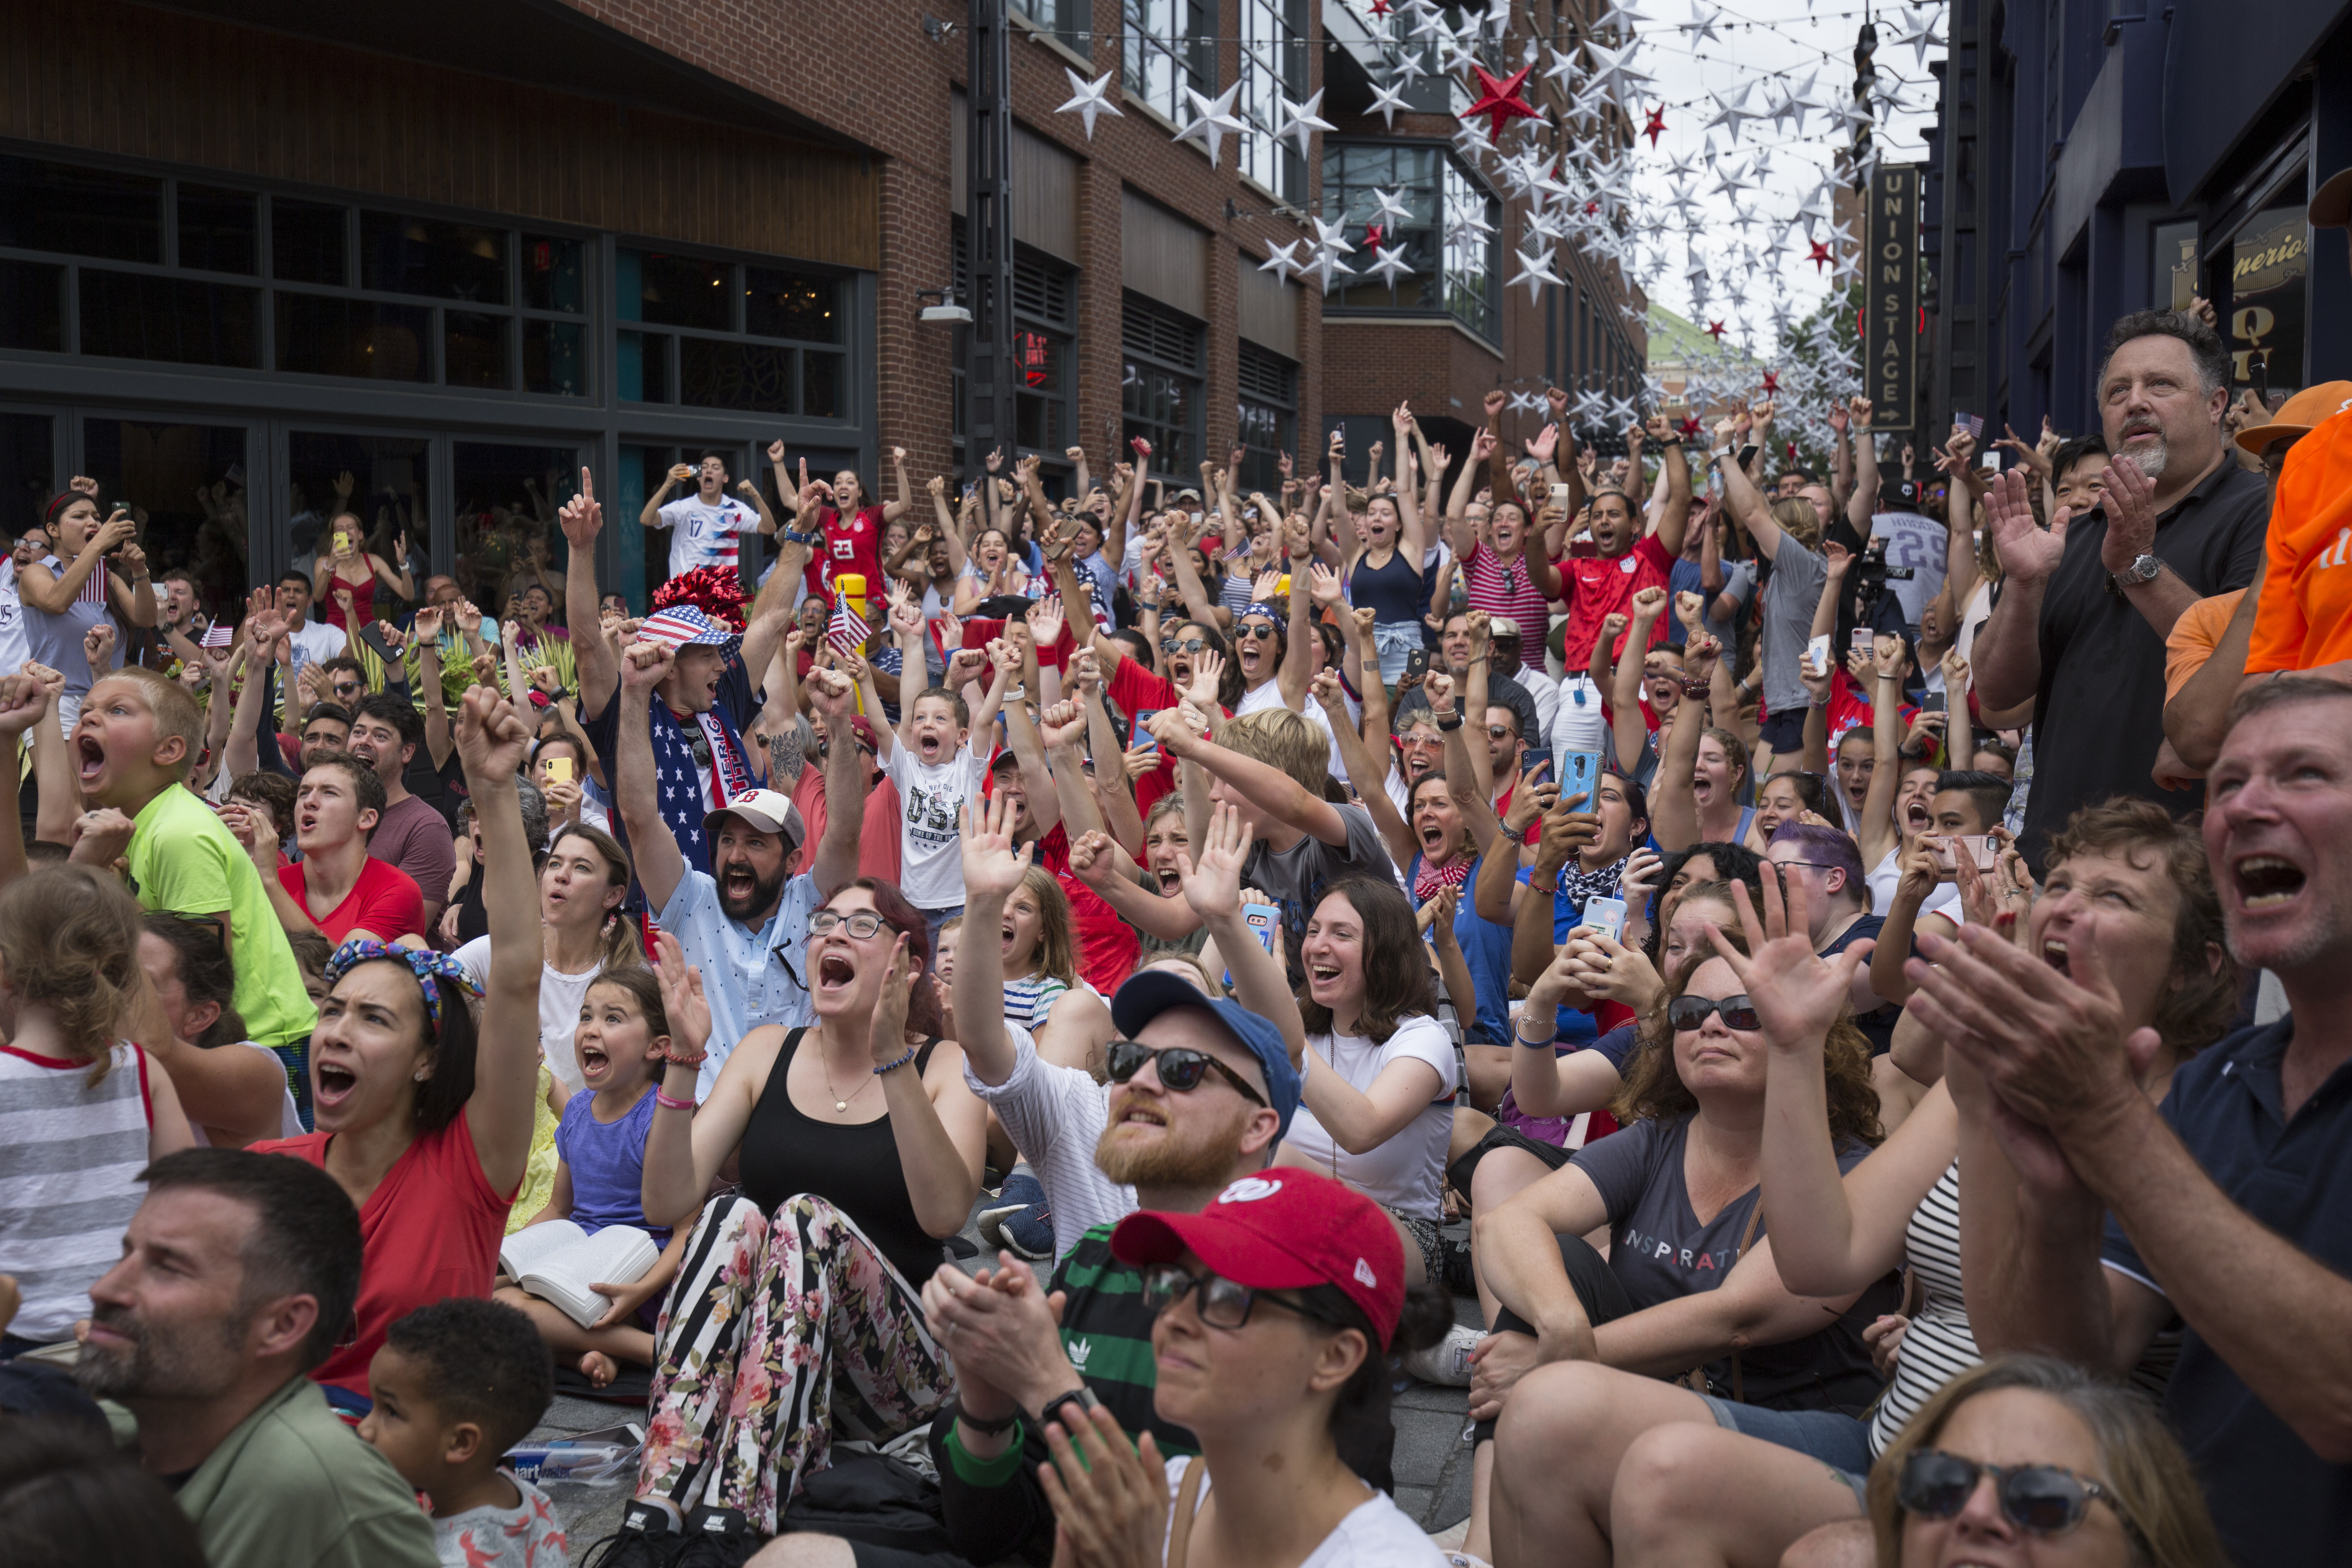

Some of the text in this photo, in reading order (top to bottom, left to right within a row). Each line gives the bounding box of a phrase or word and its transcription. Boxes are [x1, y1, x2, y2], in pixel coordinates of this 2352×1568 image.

[1882, 174, 1903, 403] UNION STAGE
[690, 520, 704, 538] 17
[833, 539, 855, 560] 23
[1896, 530, 1948, 574] 29
[1621, 557, 1635, 567] USA
[706, 719, 737, 797] MERIC
[738, 790, 759, 803] B
[912, 829, 924, 837] HOME
[1623, 1229, 1741, 1270] NSPIRAT
[629, 1510, 647, 1524] NIKE
[706, 1515, 726, 1526] NIKE
